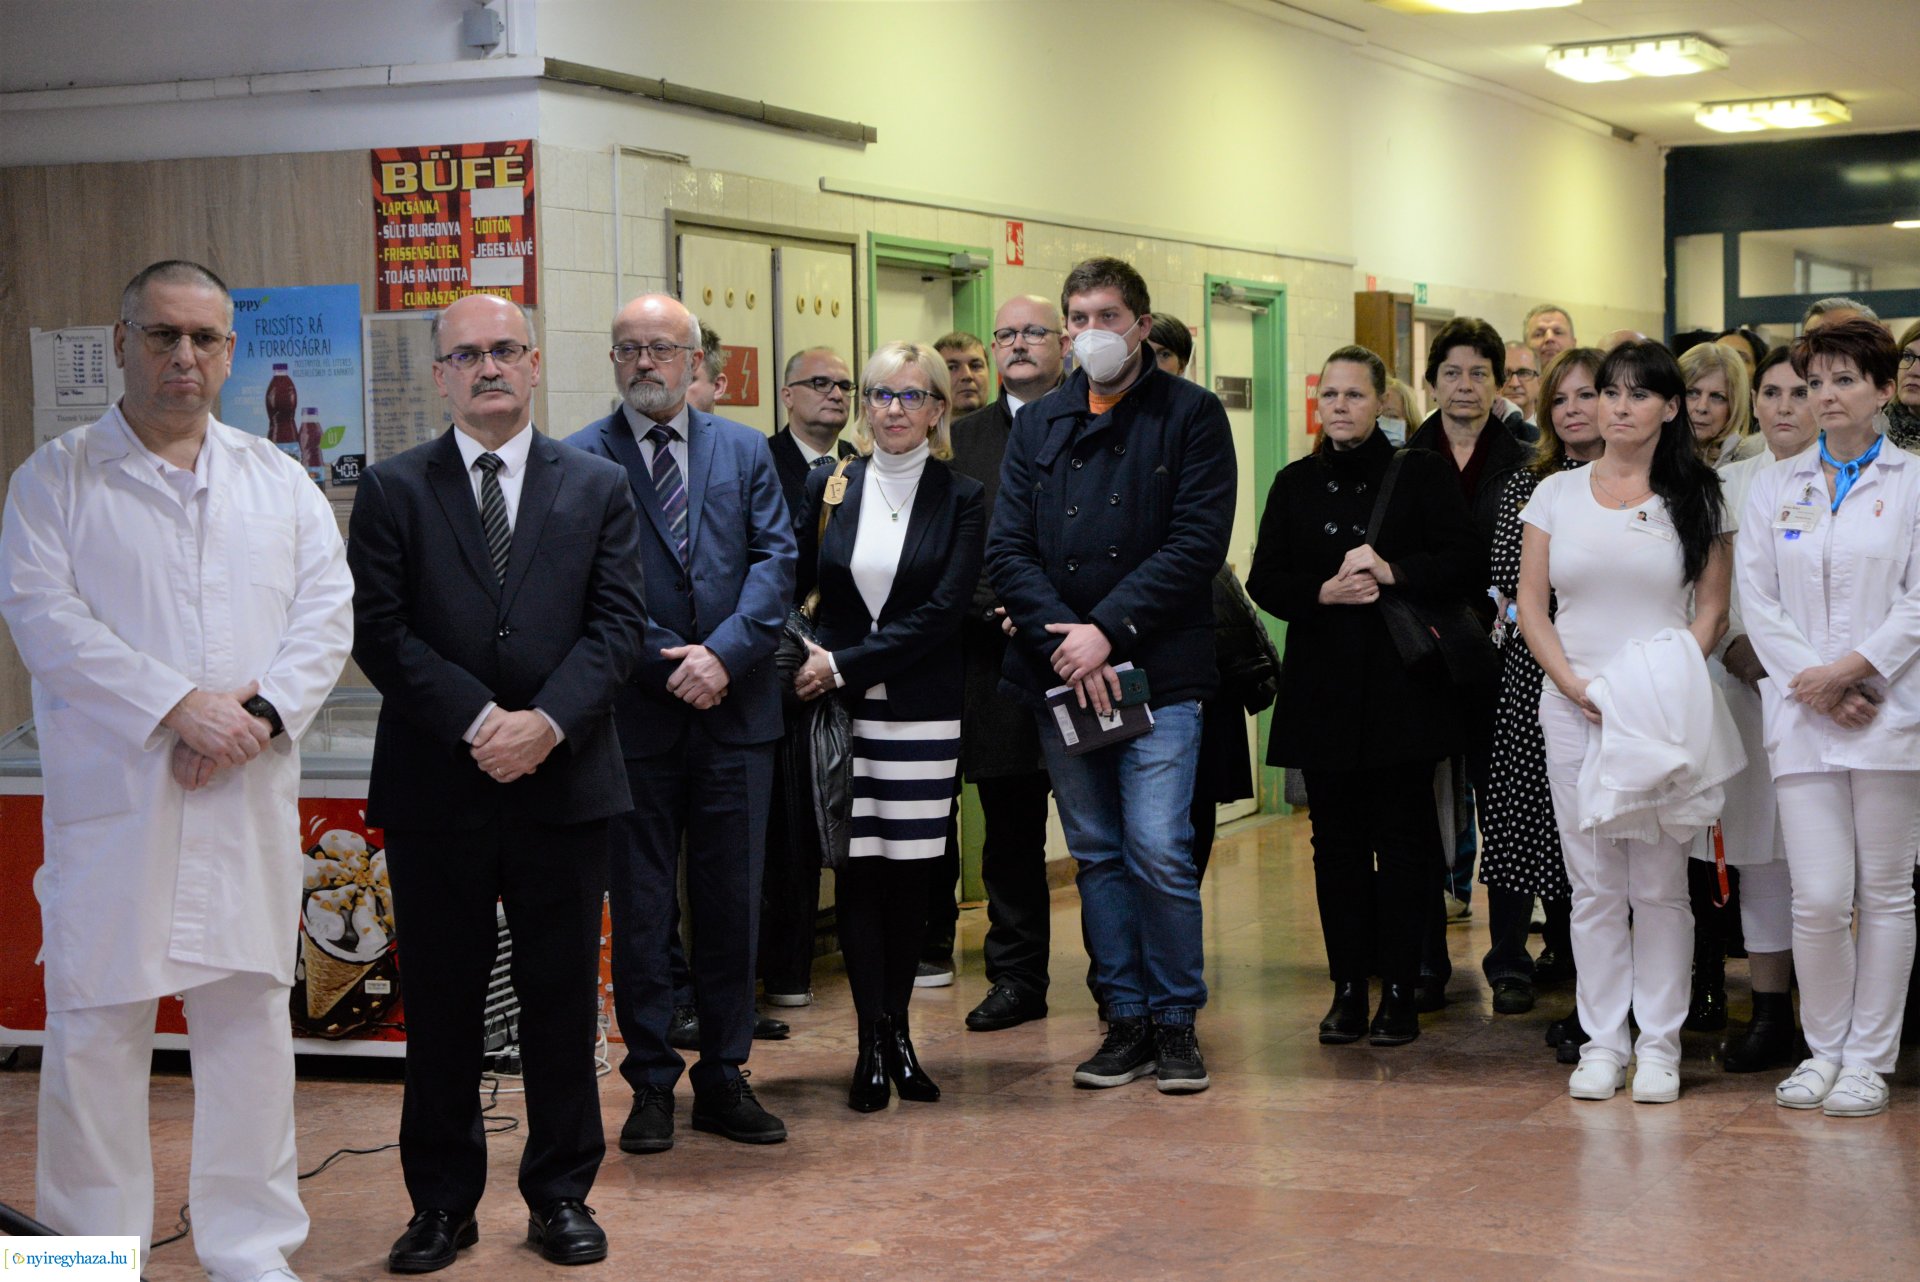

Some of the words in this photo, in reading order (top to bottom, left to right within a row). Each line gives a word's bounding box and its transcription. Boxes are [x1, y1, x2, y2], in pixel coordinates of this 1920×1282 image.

[381, 147, 525, 194] BÜFÉ
[408, 221, 461, 237] BURGONYA
[507, 237, 533, 256] KÁVÉ
[417, 266, 468, 282] RÁNTOTTA
[234, 299, 260, 312] appy
[255, 314, 304, 336] FRISSÍTS
[309, 313, 323, 334] RÁ
[248, 342, 255, 358] A
[336, 463, 358, 477] 400
